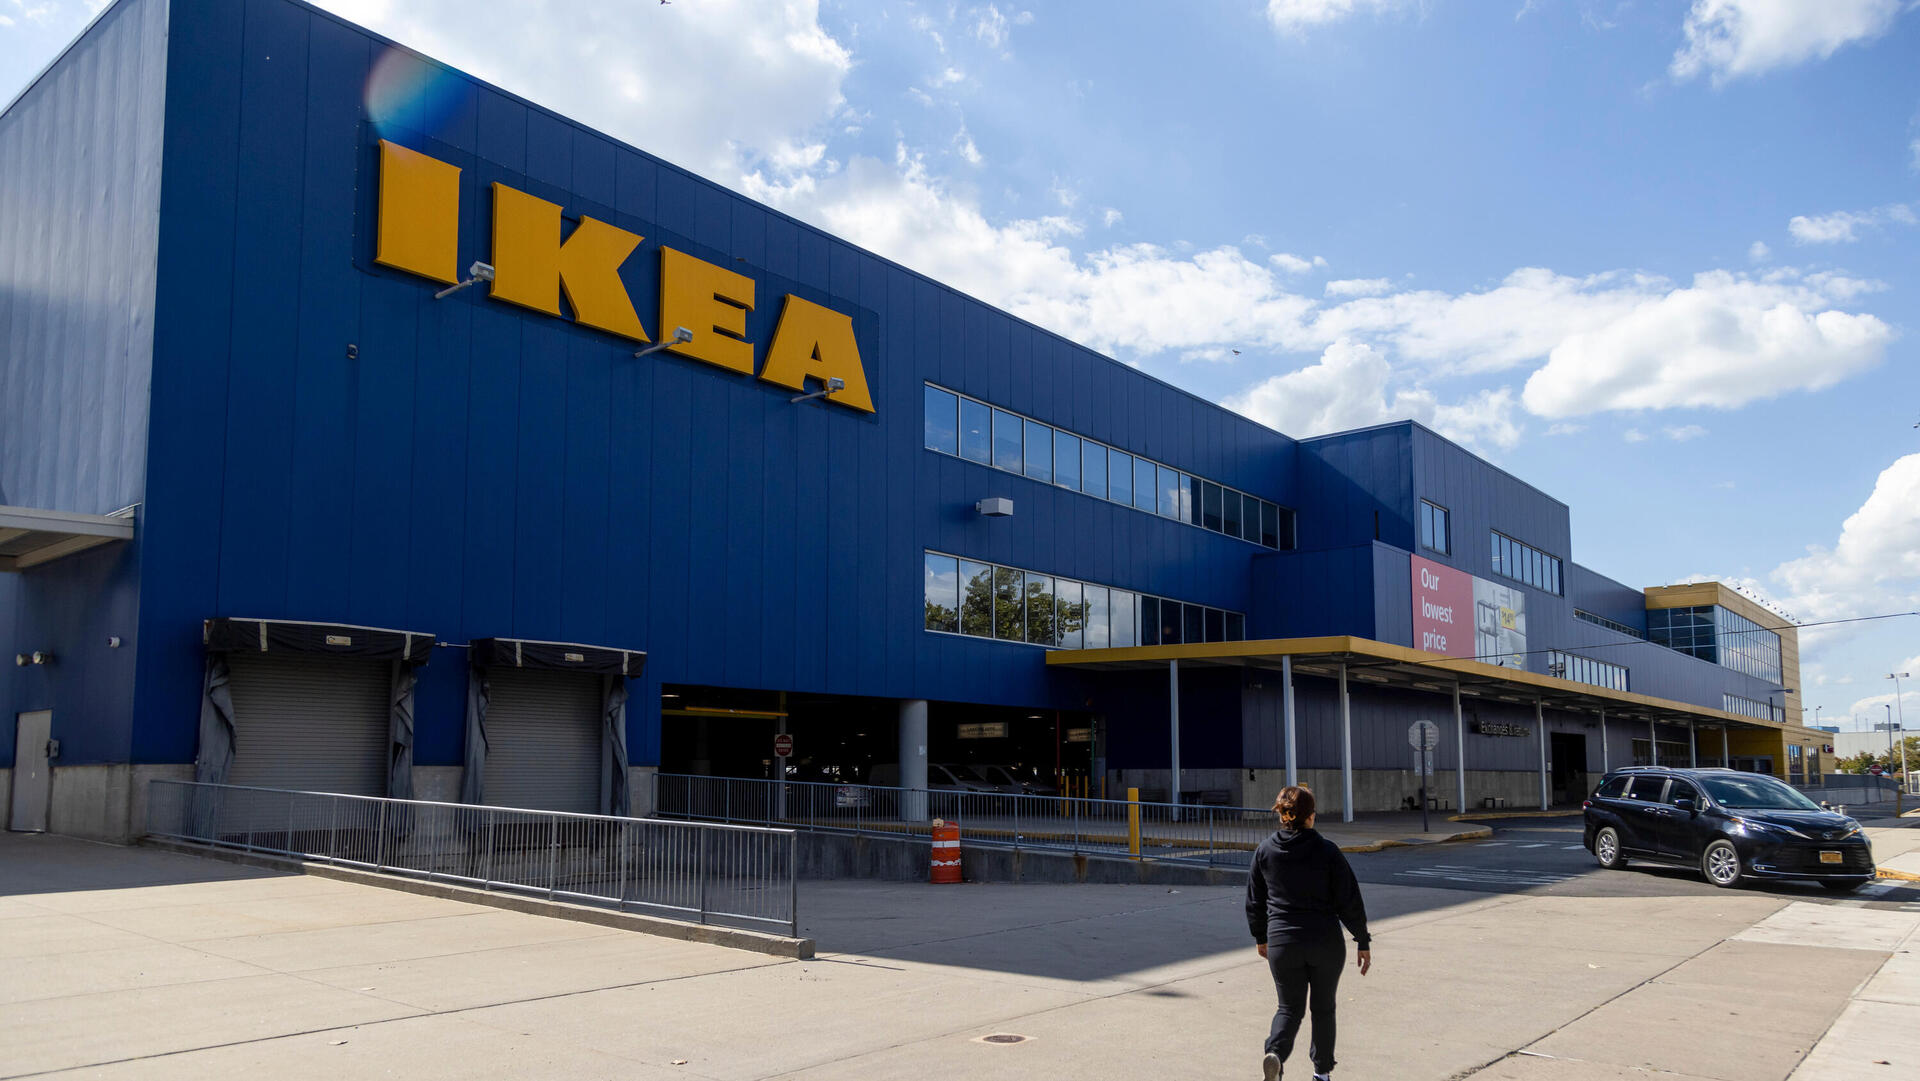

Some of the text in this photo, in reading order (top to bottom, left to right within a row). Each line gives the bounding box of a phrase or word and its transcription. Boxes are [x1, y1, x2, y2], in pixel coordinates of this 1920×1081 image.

[375, 139, 876, 413] IKEA
[1421, 567, 1439, 591] Our
[1422, 596, 1453, 624] lowest
[1423, 628, 1447, 652] price
